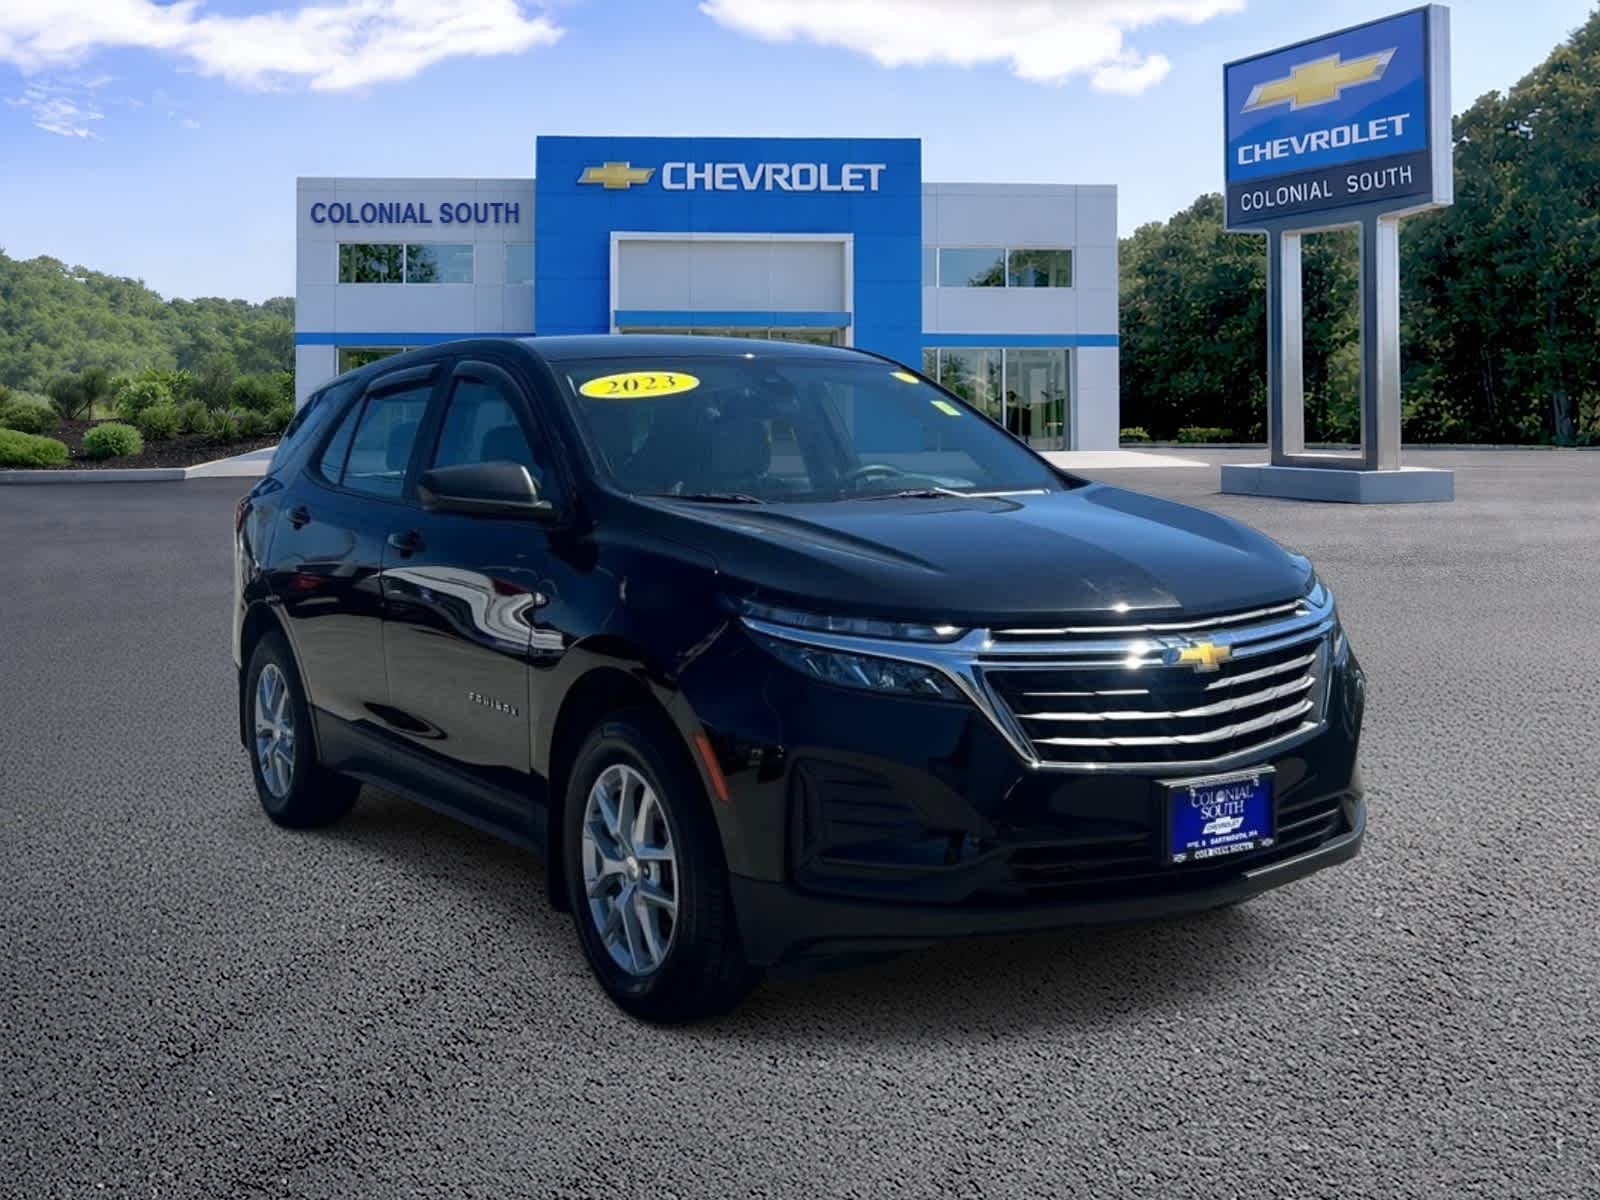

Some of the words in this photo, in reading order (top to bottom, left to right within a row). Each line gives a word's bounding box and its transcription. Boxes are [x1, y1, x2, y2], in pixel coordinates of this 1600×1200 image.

[1237, 113, 1410, 165] CHEVROLET
[662, 161, 887, 192] CHEVROLET
[1240, 180, 1333, 212] COLONIAL
[1346, 165, 1413, 194] SOUTH
[310, 202, 433, 225] COLONIAL
[439, 202, 520, 225] SOUTH
[606, 375, 676, 394] 2023
[1191, 784, 1254, 808] COLONIAL
[1200, 799, 1244, 819] SOUTH
